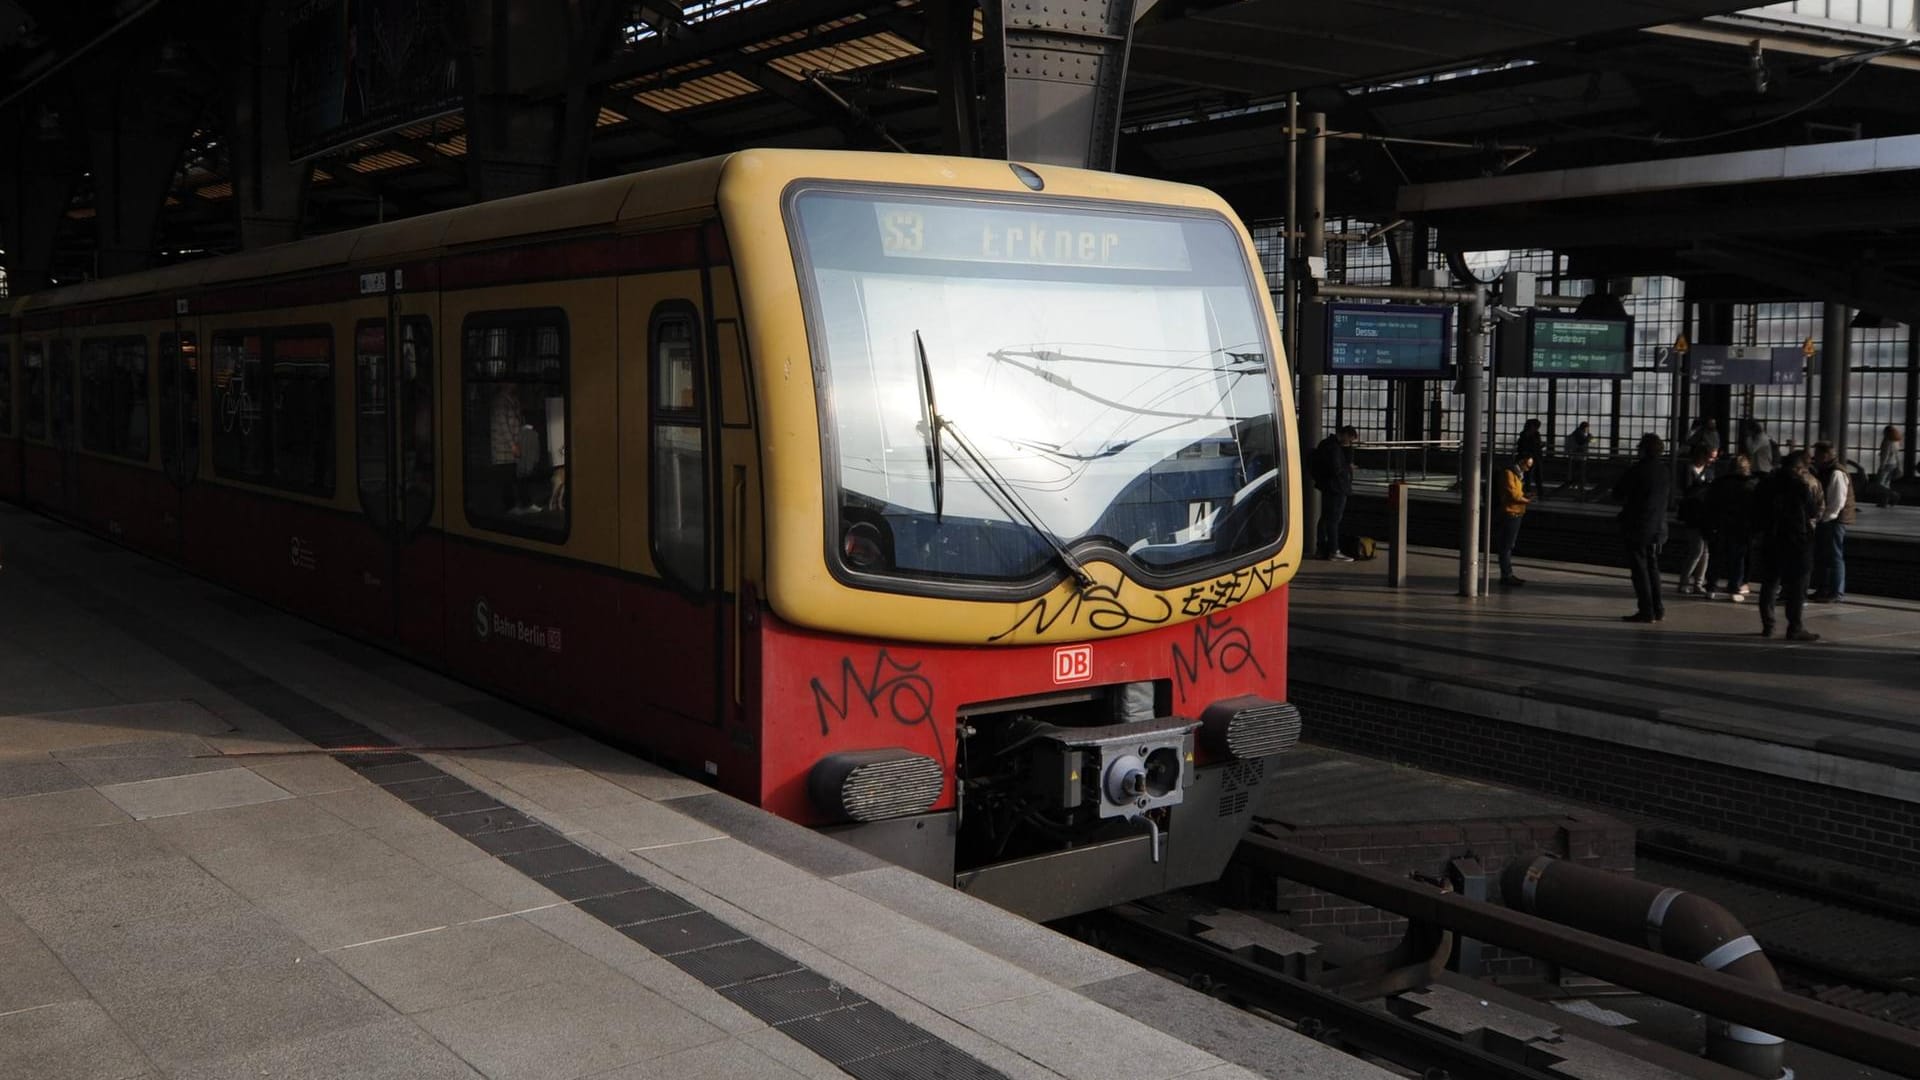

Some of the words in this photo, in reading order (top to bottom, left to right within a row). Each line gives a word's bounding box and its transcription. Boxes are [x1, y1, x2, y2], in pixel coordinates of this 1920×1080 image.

[884, 209, 925, 251] S3
[1658, 347, 1669, 367] 2
[493, 611, 517, 640] Bahn
[517, 620, 546, 648] Berlin
[1058, 650, 1089, 678] DB
